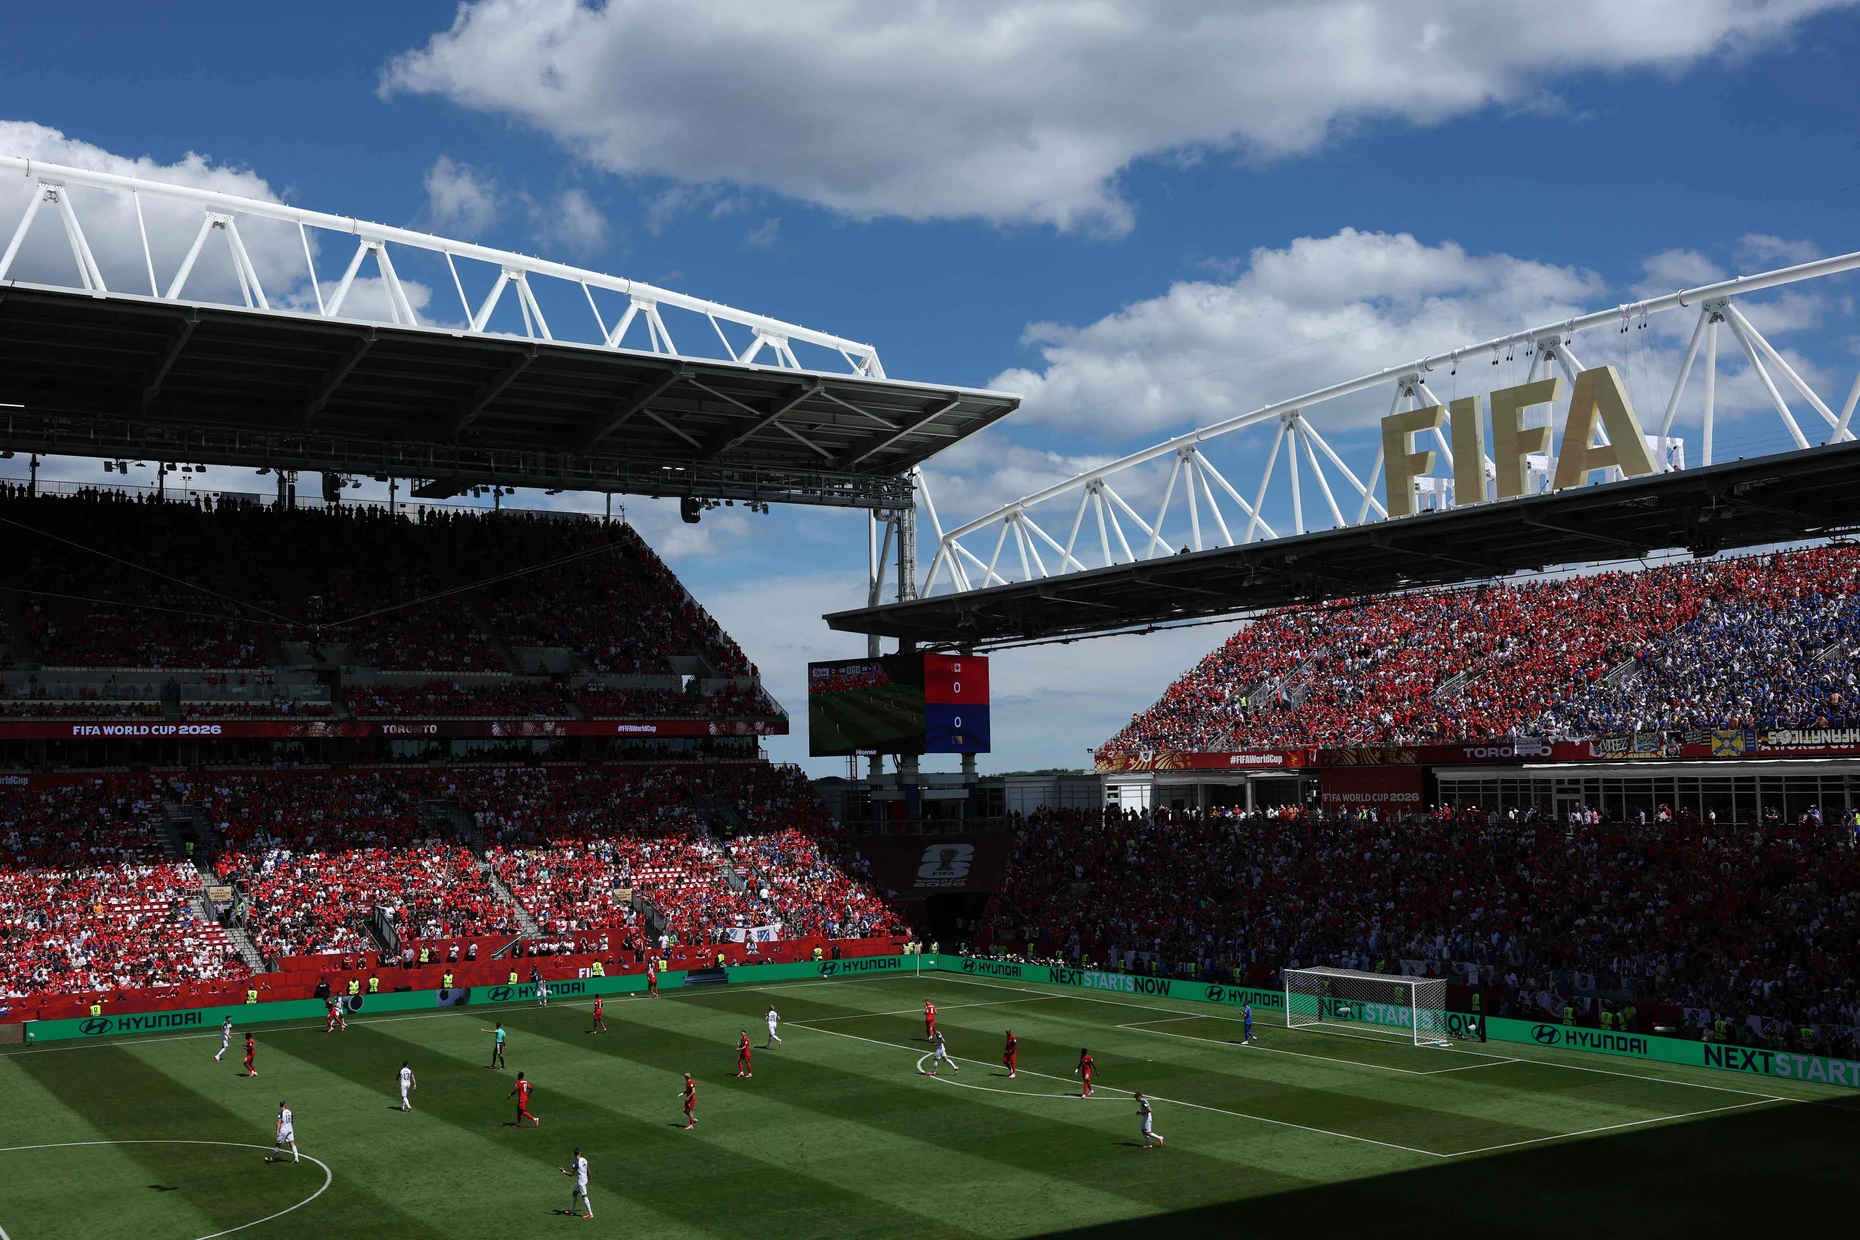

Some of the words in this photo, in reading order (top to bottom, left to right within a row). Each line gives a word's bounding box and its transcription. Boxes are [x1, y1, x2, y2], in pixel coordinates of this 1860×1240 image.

[1381, 365, 1660, 518] FIFA
[953, 681, 961, 693] 0
[382, 724, 438, 734] TORONTO
[617, 724, 657, 734] #FIFAWorldCup
[954, 716, 962, 728] 0
[72, 725, 101, 735] FIFA
[102, 725, 150, 735] WORLD
[151, 725, 177, 735] CUP
[178, 725, 222, 735] 2026
[1768, 728, 1860, 745] HFANATICS
[1463, 745, 1553, 758] TOROO
[1230, 754, 1283, 765] #FIFAWorldCup
[1324, 793, 1341, 802] FIFA
[1342, 793, 1371, 802] WORLD
[1372, 793, 1389, 802] CUP
[1390, 792, 1420, 802] 2026
[842, 957, 901, 972] HYUNDAI
[978, 962, 1022, 978] HYUNDAI
[518, 981, 585, 998] HYNDAI
[1228, 989, 1284, 1008] HYUNDAI
[118, 1012, 202, 1031] HYUNDAI
[1565, 1029, 1648, 1055] HYUNDAI
